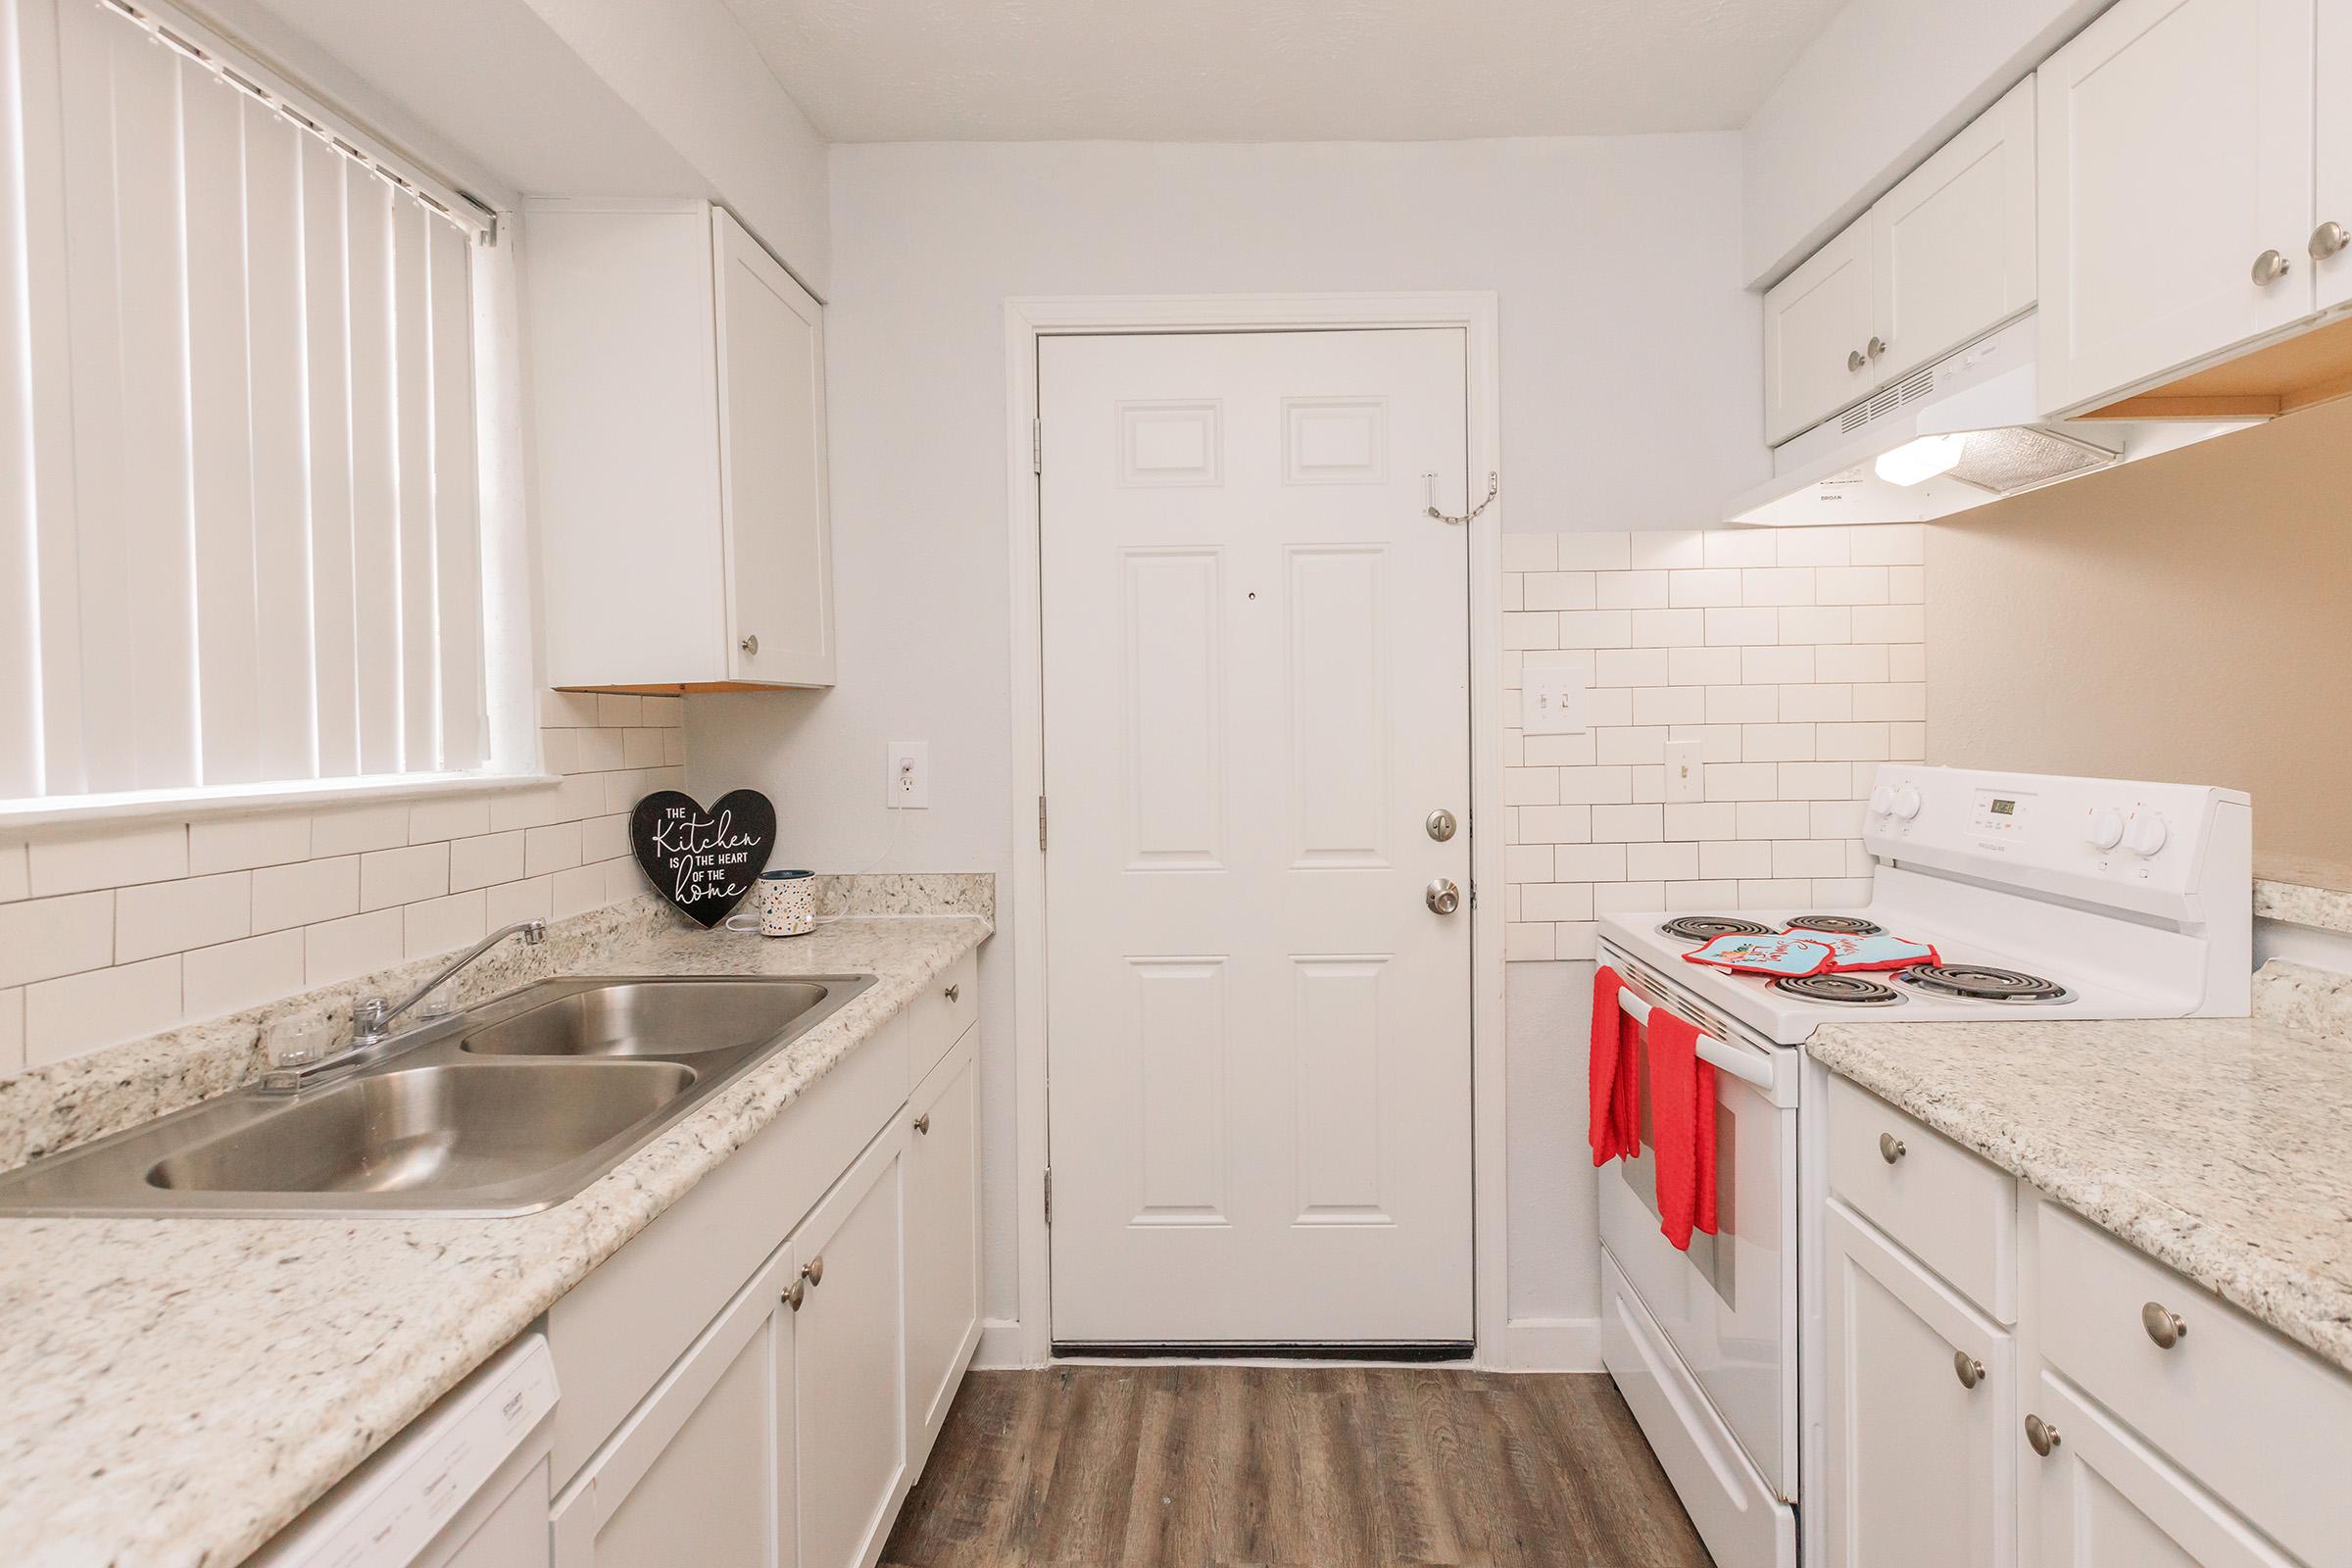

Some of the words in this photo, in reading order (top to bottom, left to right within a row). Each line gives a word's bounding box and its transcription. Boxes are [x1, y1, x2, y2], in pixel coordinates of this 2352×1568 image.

[666, 808, 686, 818] THE
[652, 809, 761, 858] Kitchen
[669, 858, 680, 868] IS
[695, 855, 714, 866] THE
[718, 852, 748, 864] HEART
[675, 855, 747, 905] home
[692, 871, 705, 882] OF
[708, 869, 725, 881] THE
